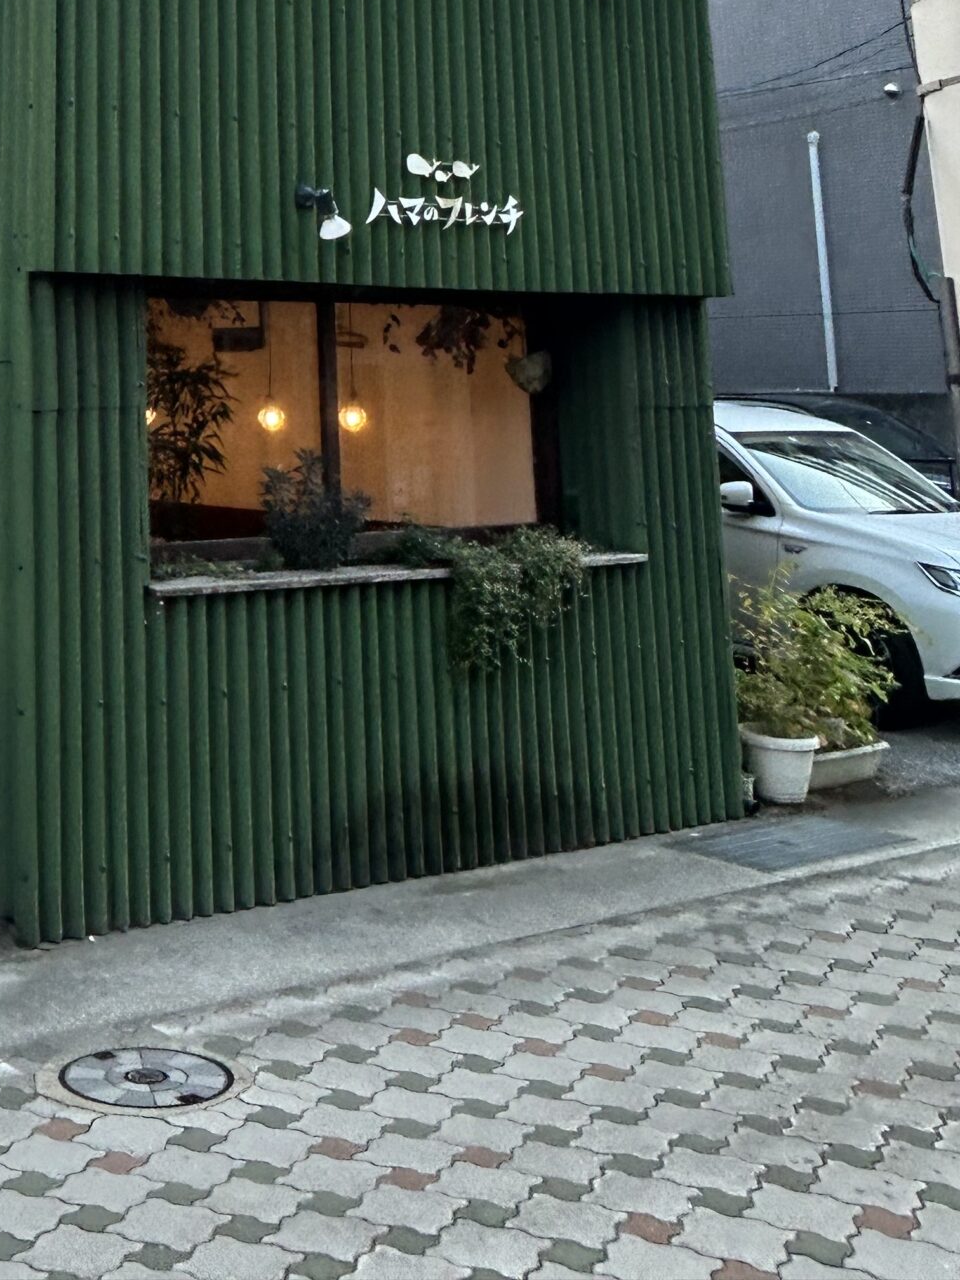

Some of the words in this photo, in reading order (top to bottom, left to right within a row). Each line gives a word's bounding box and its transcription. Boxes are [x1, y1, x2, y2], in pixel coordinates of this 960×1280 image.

[366, 187, 524, 236] ハマのフレンチ
